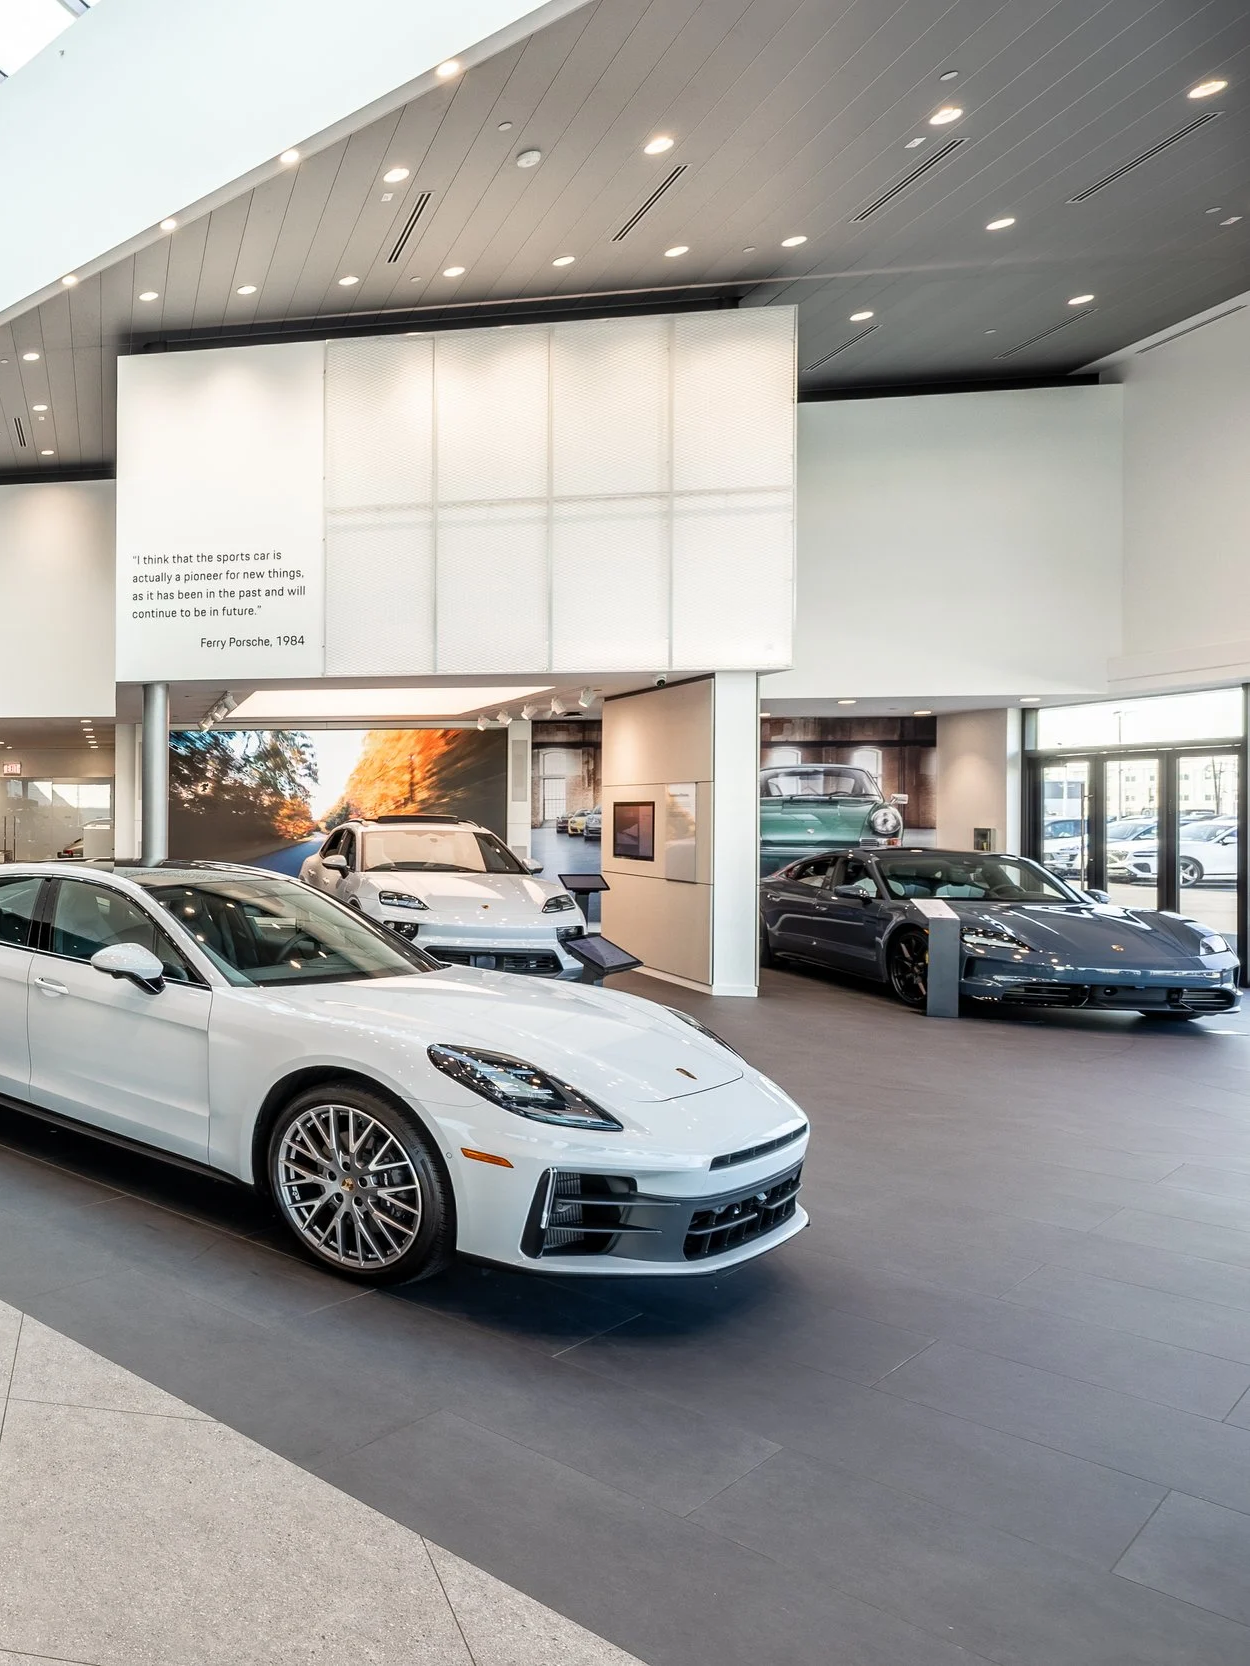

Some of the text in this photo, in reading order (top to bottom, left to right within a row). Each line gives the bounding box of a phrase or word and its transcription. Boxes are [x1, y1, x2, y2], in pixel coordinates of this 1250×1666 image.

[133, 550, 281, 565] "I think that the sports car is
[133, 572, 172, 584] actually
[184, 571, 223, 583] pioneer
[226, 570, 240, 580] for
[243, 571, 265, 579] new
[268, 568, 304, 580] things,
[133, 586, 305, 601] as it has been in the past and will
[132, 605, 261, 619] continue to be in future."
[201, 635, 305, 650] Ferry Porsche, 1984
